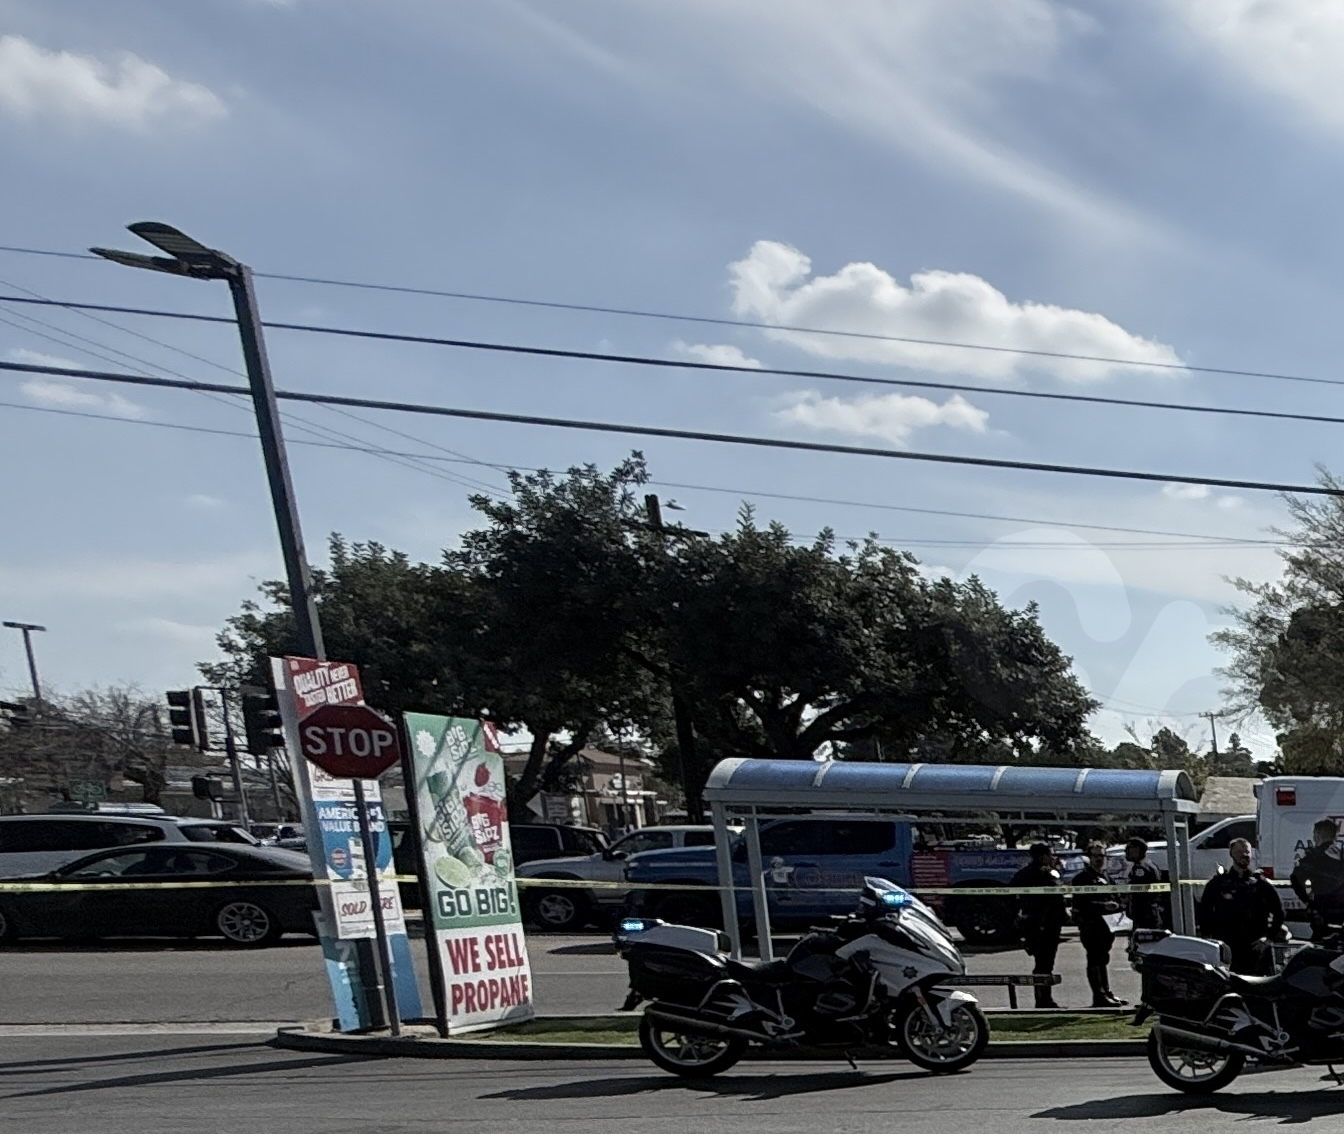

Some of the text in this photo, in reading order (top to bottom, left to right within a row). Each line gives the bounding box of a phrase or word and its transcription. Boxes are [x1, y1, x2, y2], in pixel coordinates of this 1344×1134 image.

[293, 667, 331, 697] QUALITY
[305, 726, 393, 757] STOP
[322, 821, 385, 832] VALUE BND
[472, 813, 490, 829] BIG
[341, 901, 368, 917] SOLD
[438, 881, 516, 917] GO BIG!
[445, 933, 524, 975] WE SELL
[451, 974, 529, 1016] PROPANE
